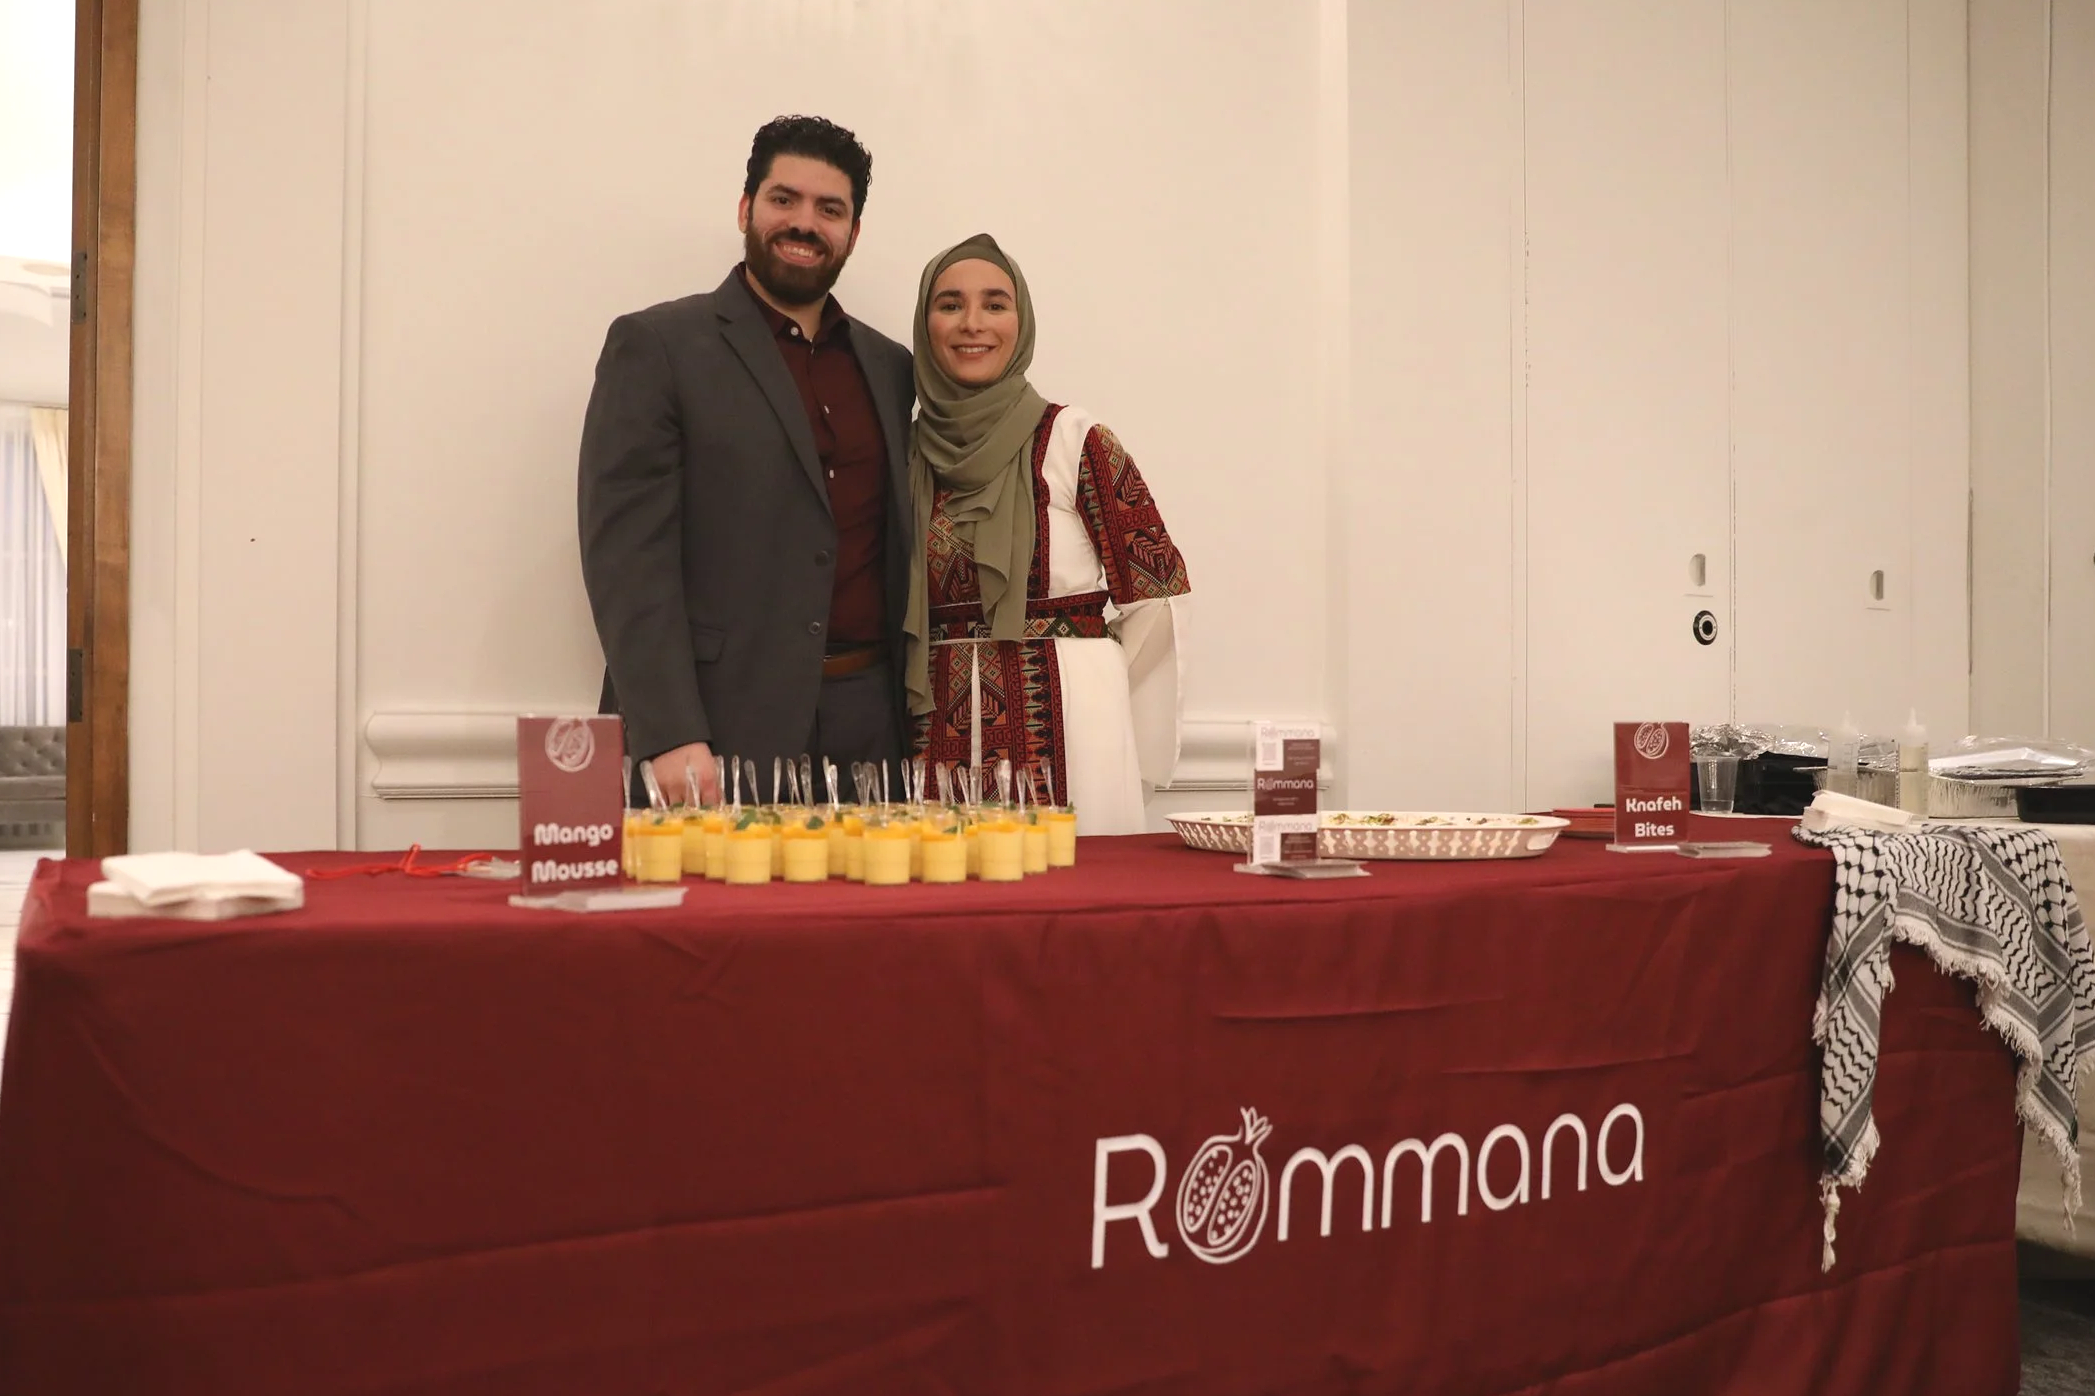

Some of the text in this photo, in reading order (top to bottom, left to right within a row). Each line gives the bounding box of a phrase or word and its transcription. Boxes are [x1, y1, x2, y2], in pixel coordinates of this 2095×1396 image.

[1625, 796, 1682, 813] Knafeh
[534, 823, 614, 847] Mango
[1634, 822, 1675, 838] Bites
[531, 859, 619, 883] Mousse
